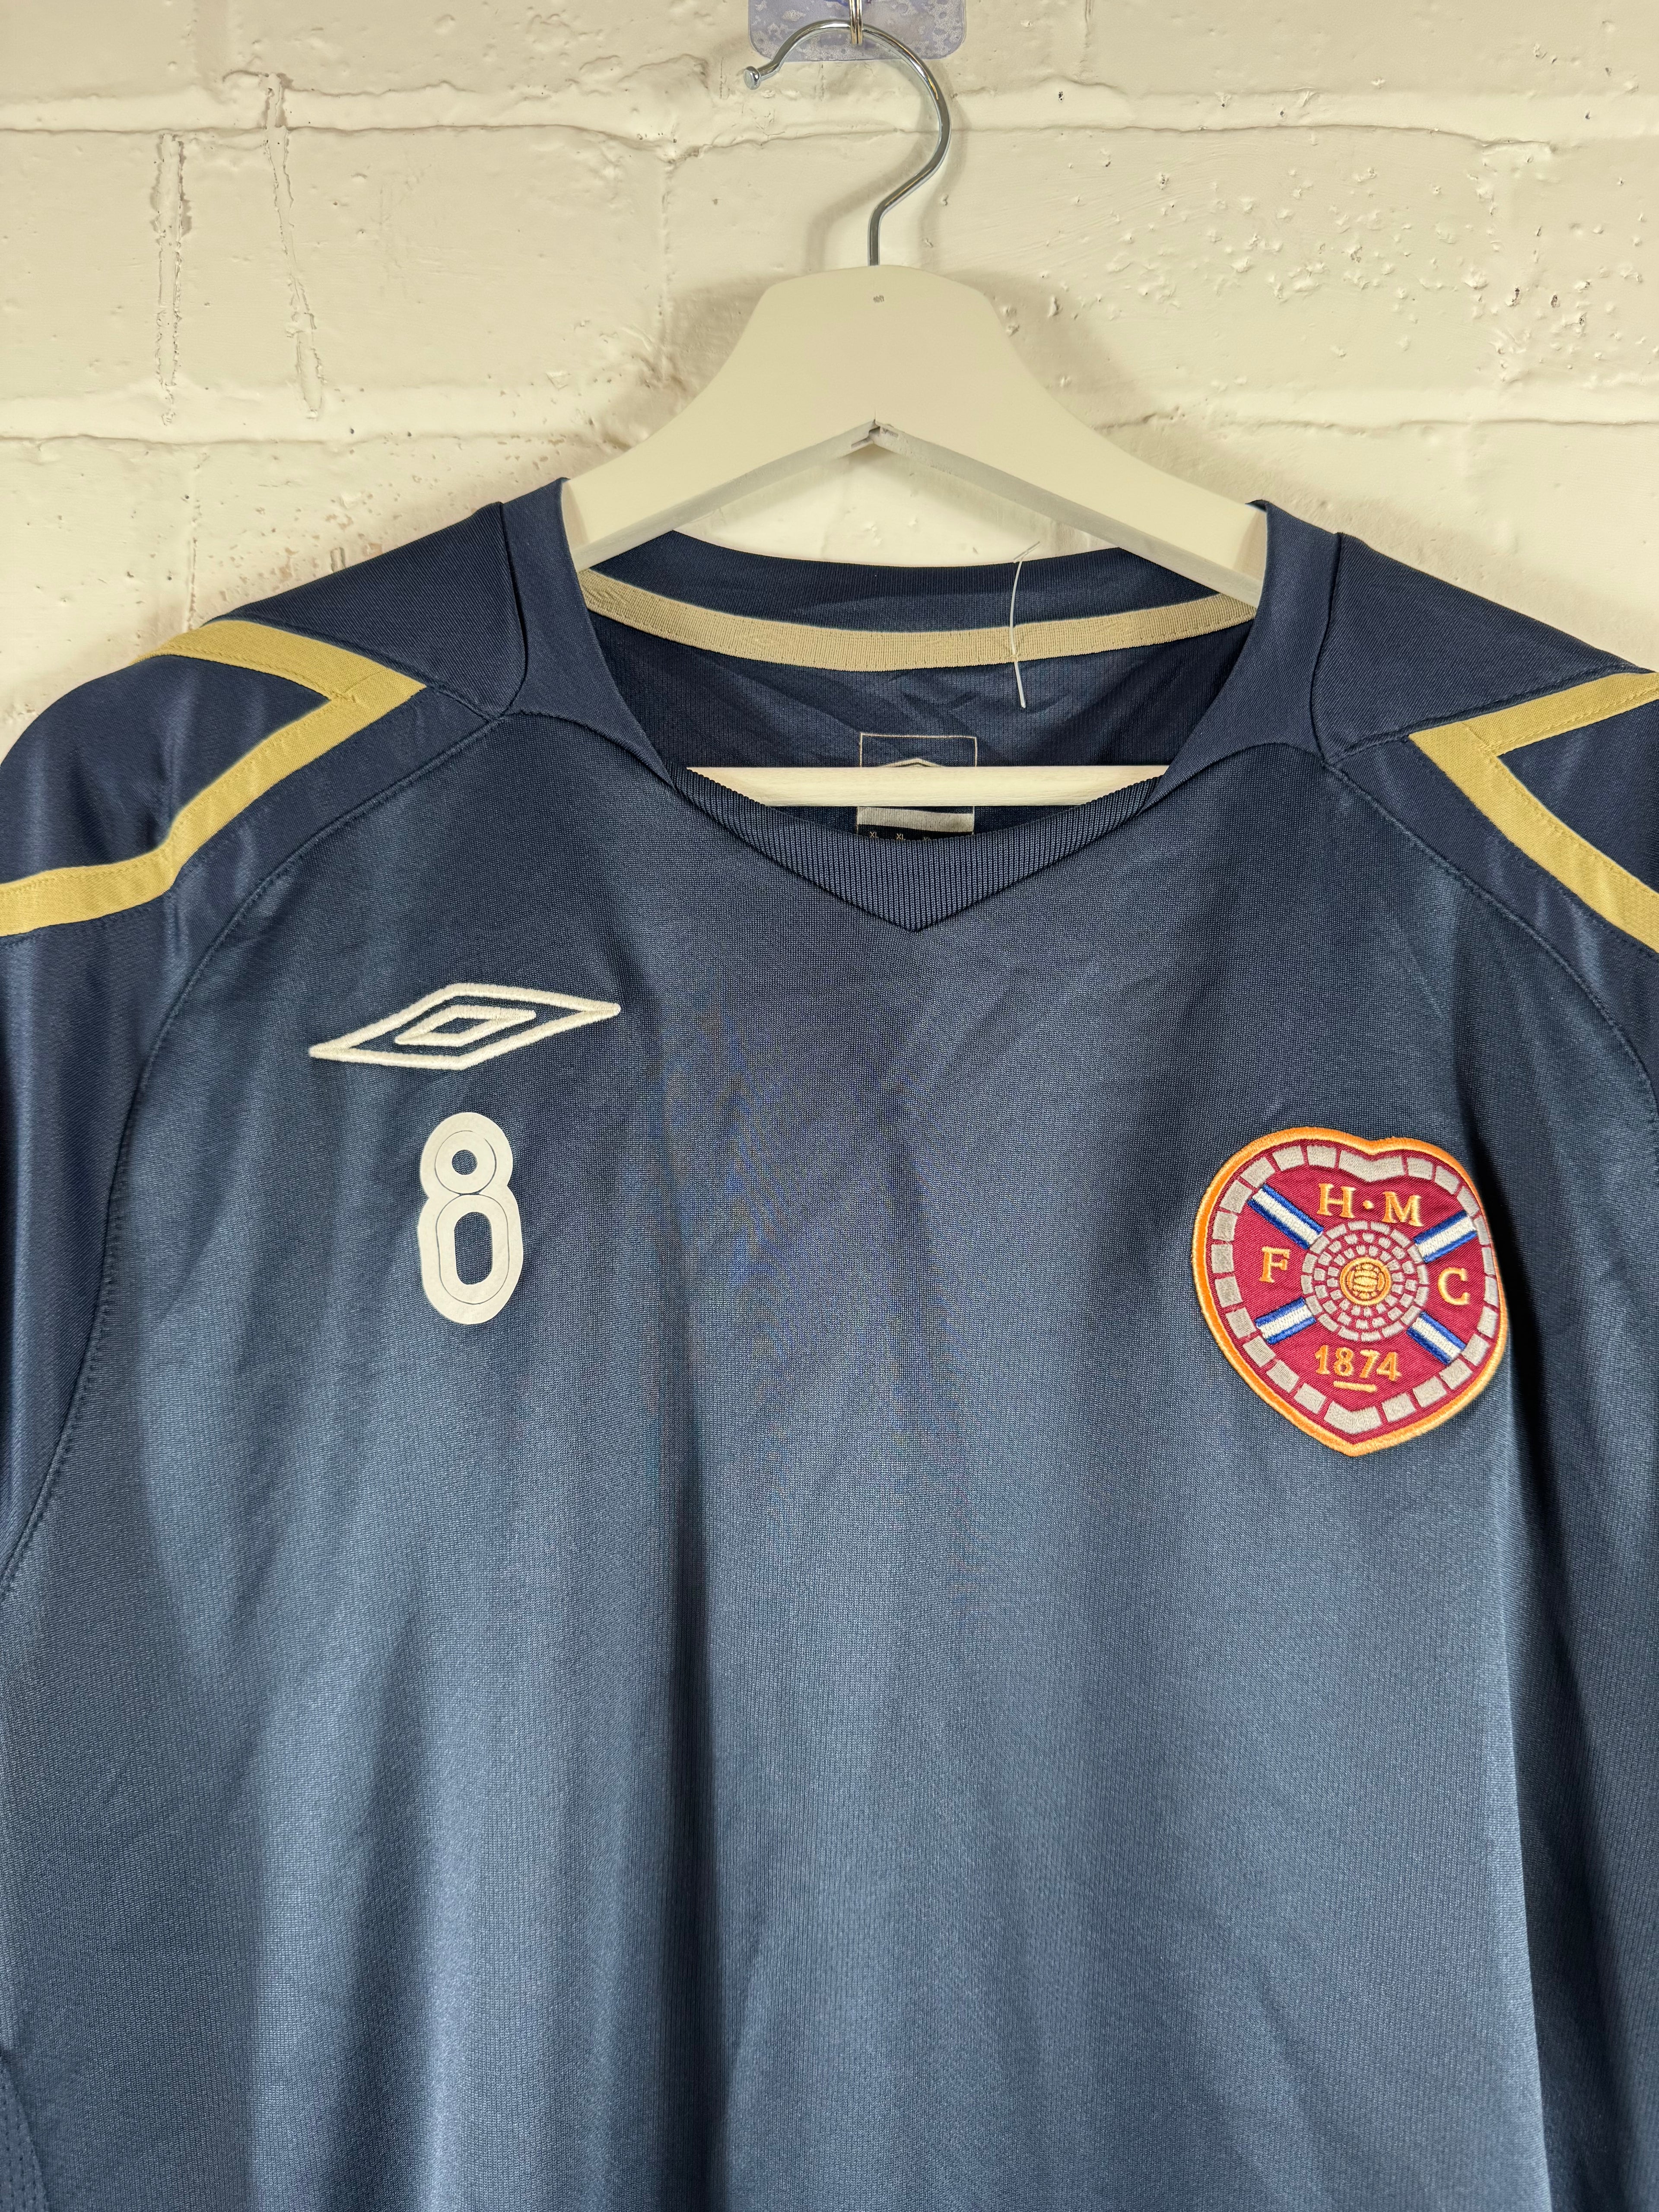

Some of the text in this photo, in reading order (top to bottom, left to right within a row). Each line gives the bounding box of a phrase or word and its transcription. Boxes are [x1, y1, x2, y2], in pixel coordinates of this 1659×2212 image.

[418, 1112, 524, 1325] 8
[1259, 1246, 1470, 1306] F C
[1314, 1344, 1402, 1381] 1874
